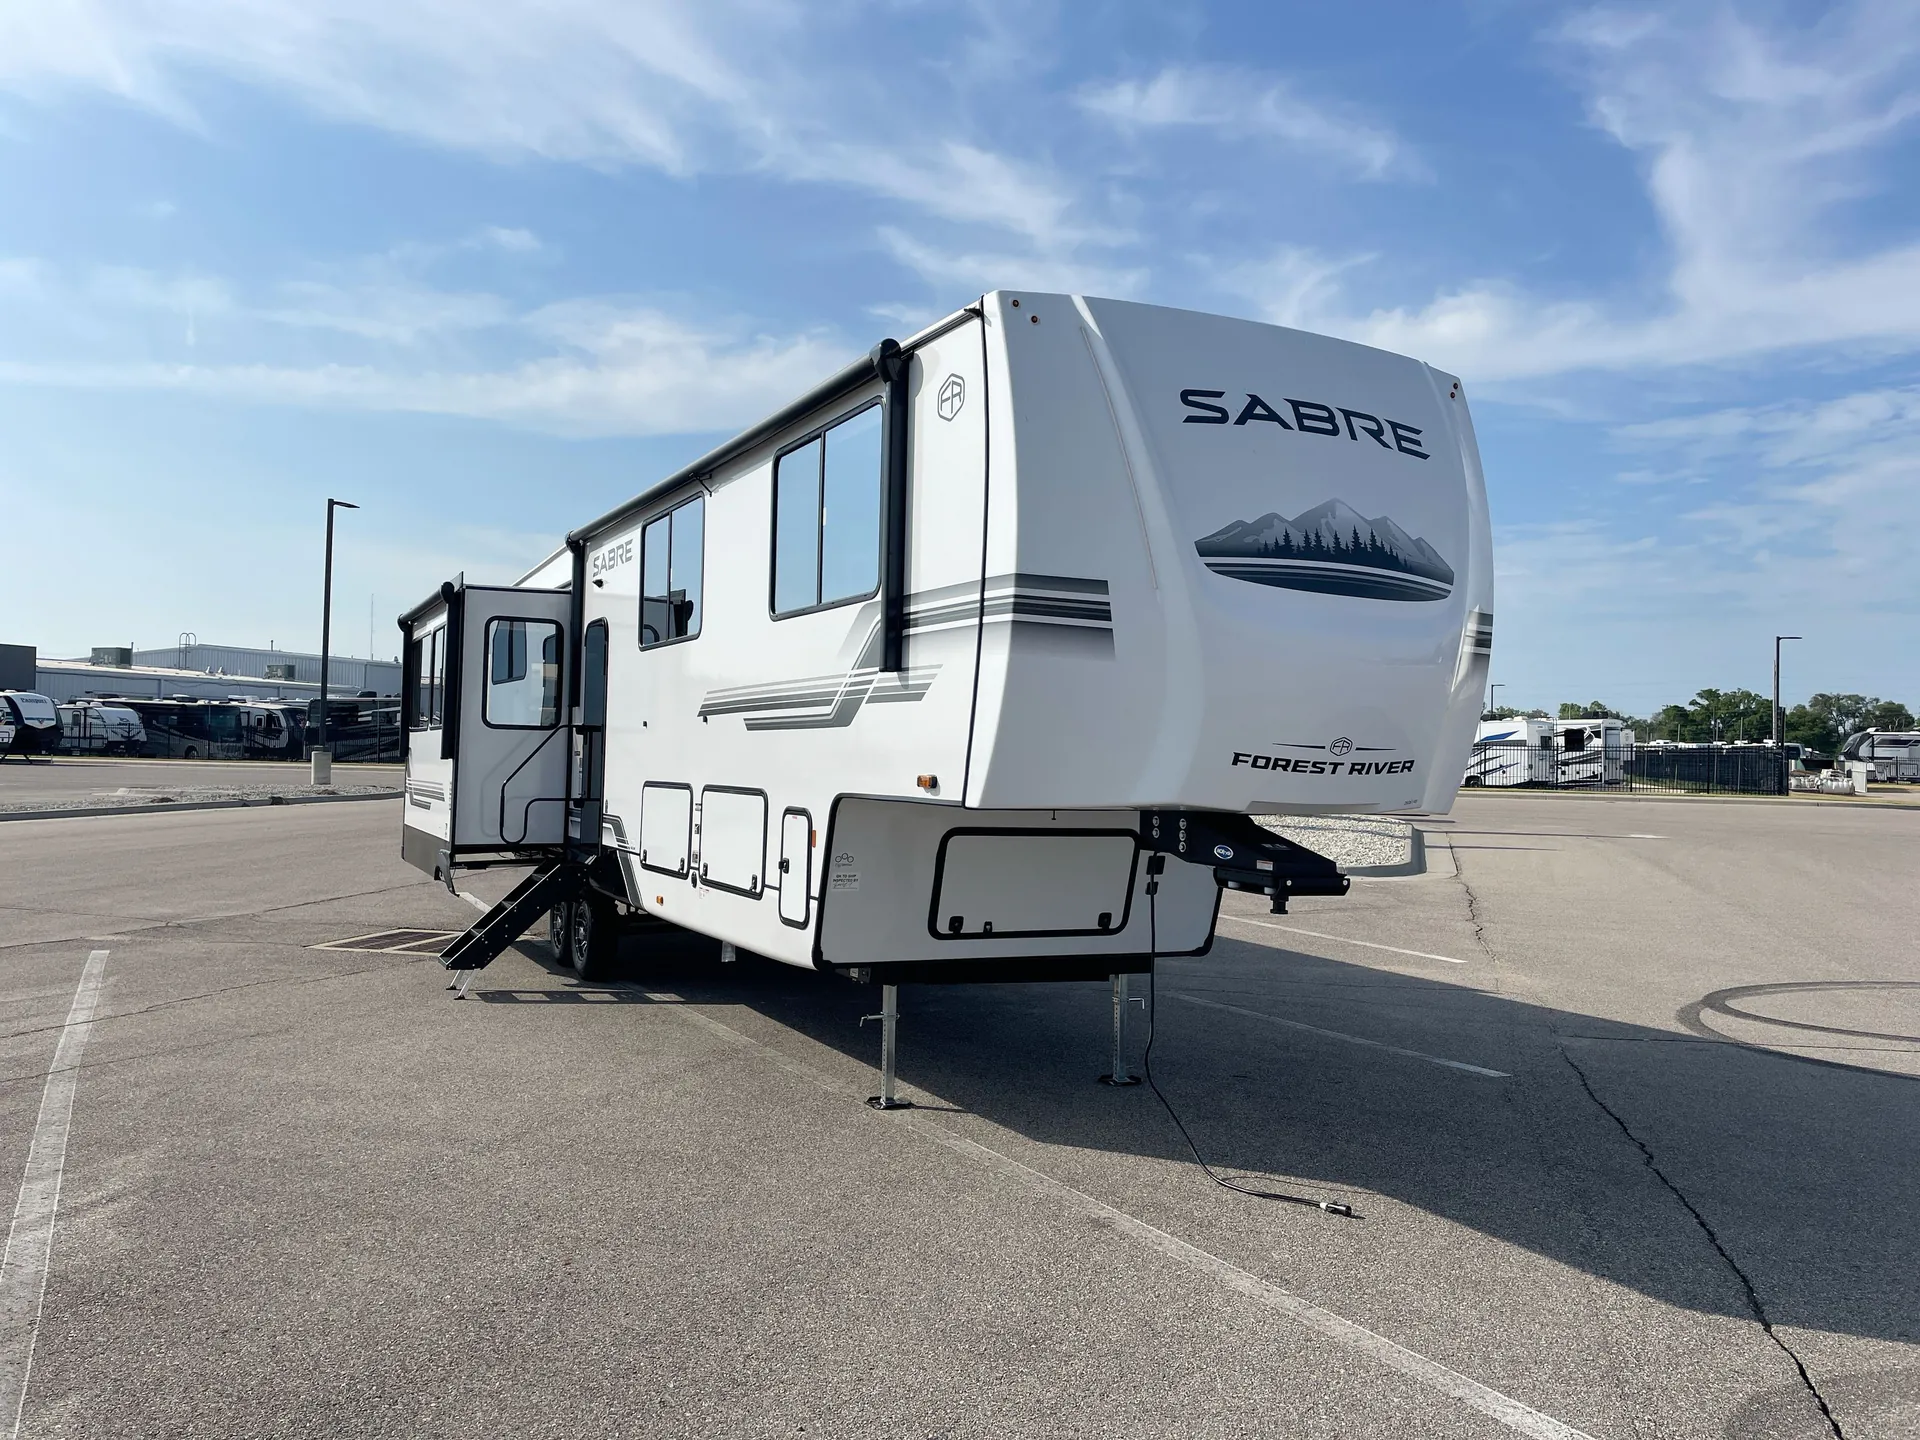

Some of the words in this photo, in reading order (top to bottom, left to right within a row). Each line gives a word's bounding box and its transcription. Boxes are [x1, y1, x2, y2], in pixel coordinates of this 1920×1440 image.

[1179, 388, 1431, 460] SABRE
[592, 538, 634, 578] SABRE
[1231, 751, 1345, 775] FOREST
[1347, 759, 1415, 776] RIVER
